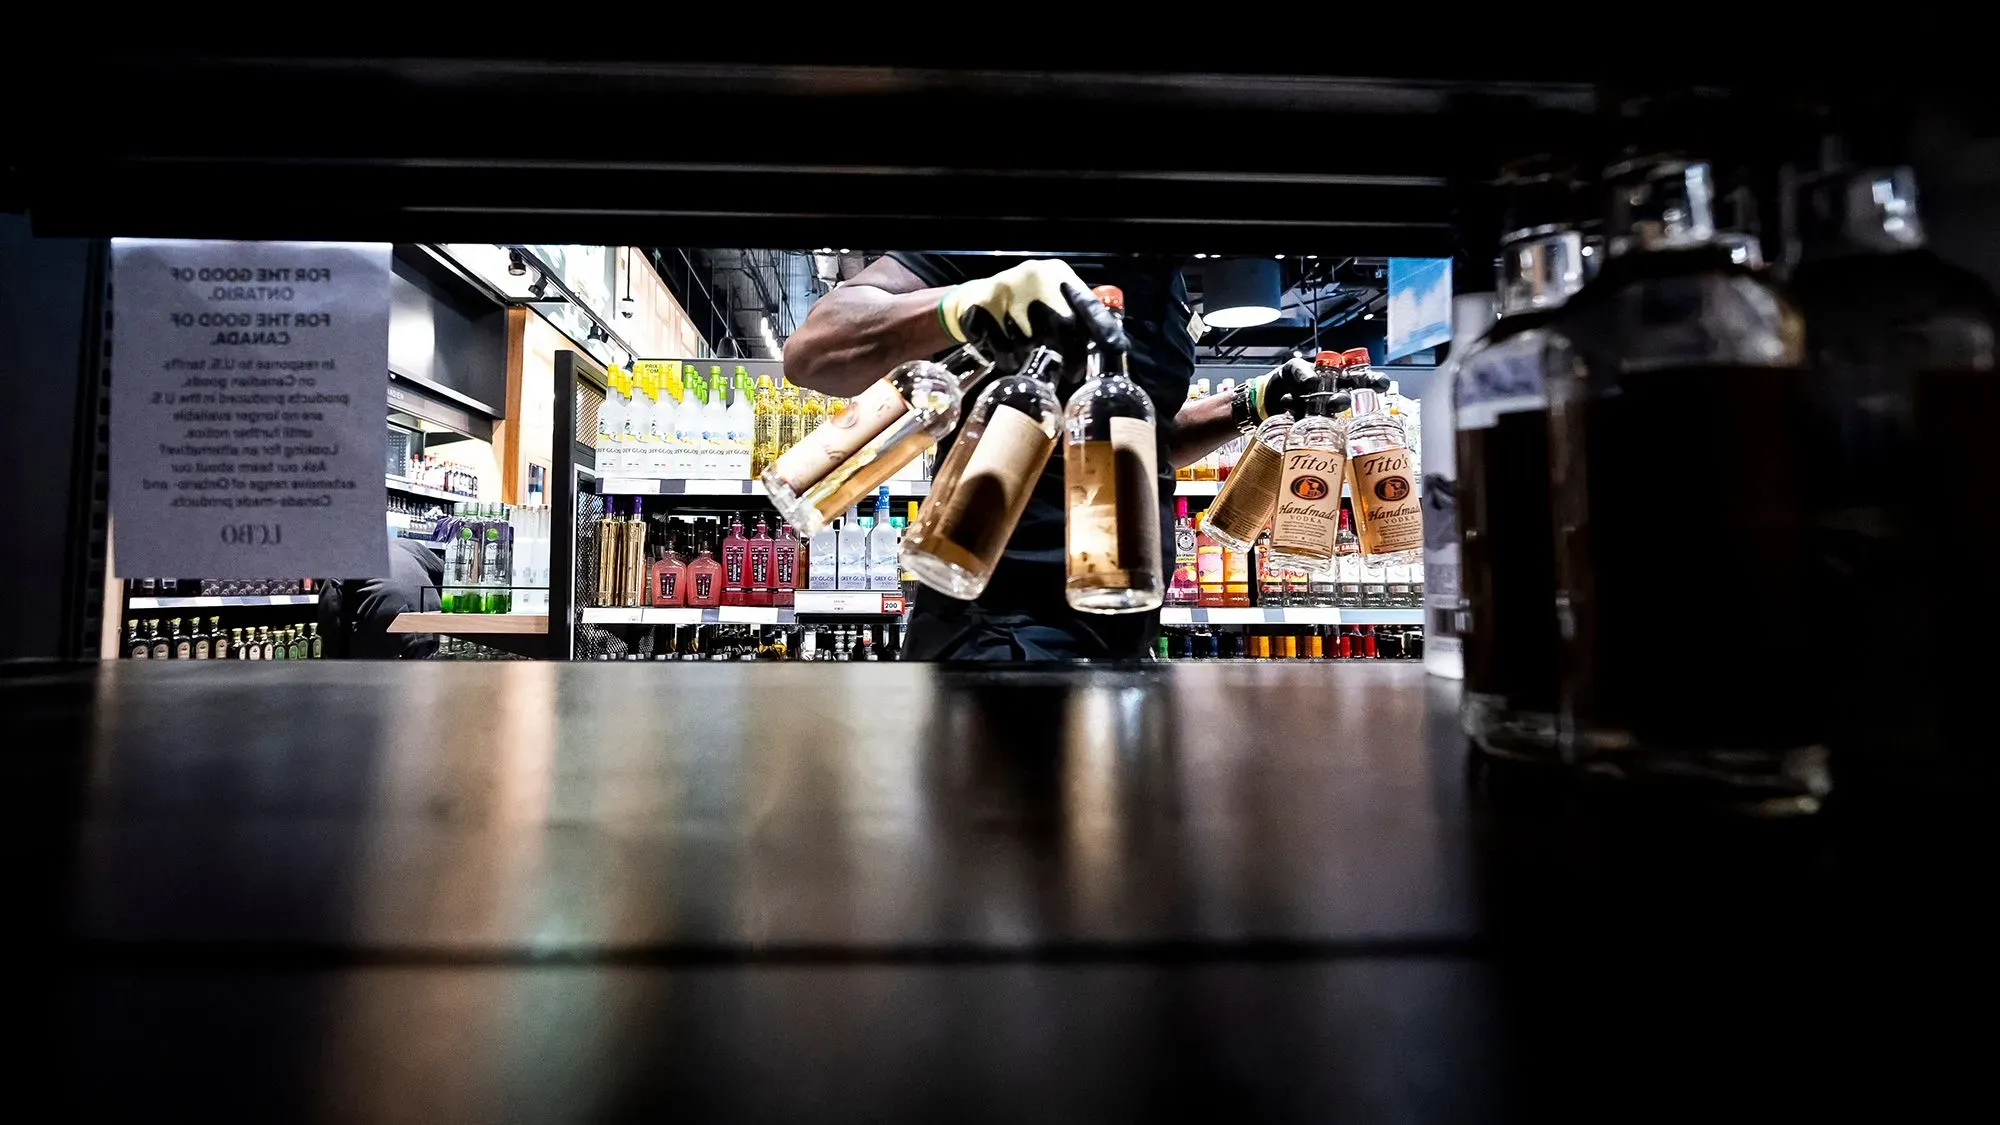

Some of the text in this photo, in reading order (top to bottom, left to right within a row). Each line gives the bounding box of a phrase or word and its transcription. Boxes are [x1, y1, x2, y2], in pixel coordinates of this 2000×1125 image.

[1289, 453, 1338, 474] Tito's
[1364, 454, 1409, 475] Tito's
[1279, 502, 1336, 521] Handmade
[1289, 514, 1323, 525] VODKA
